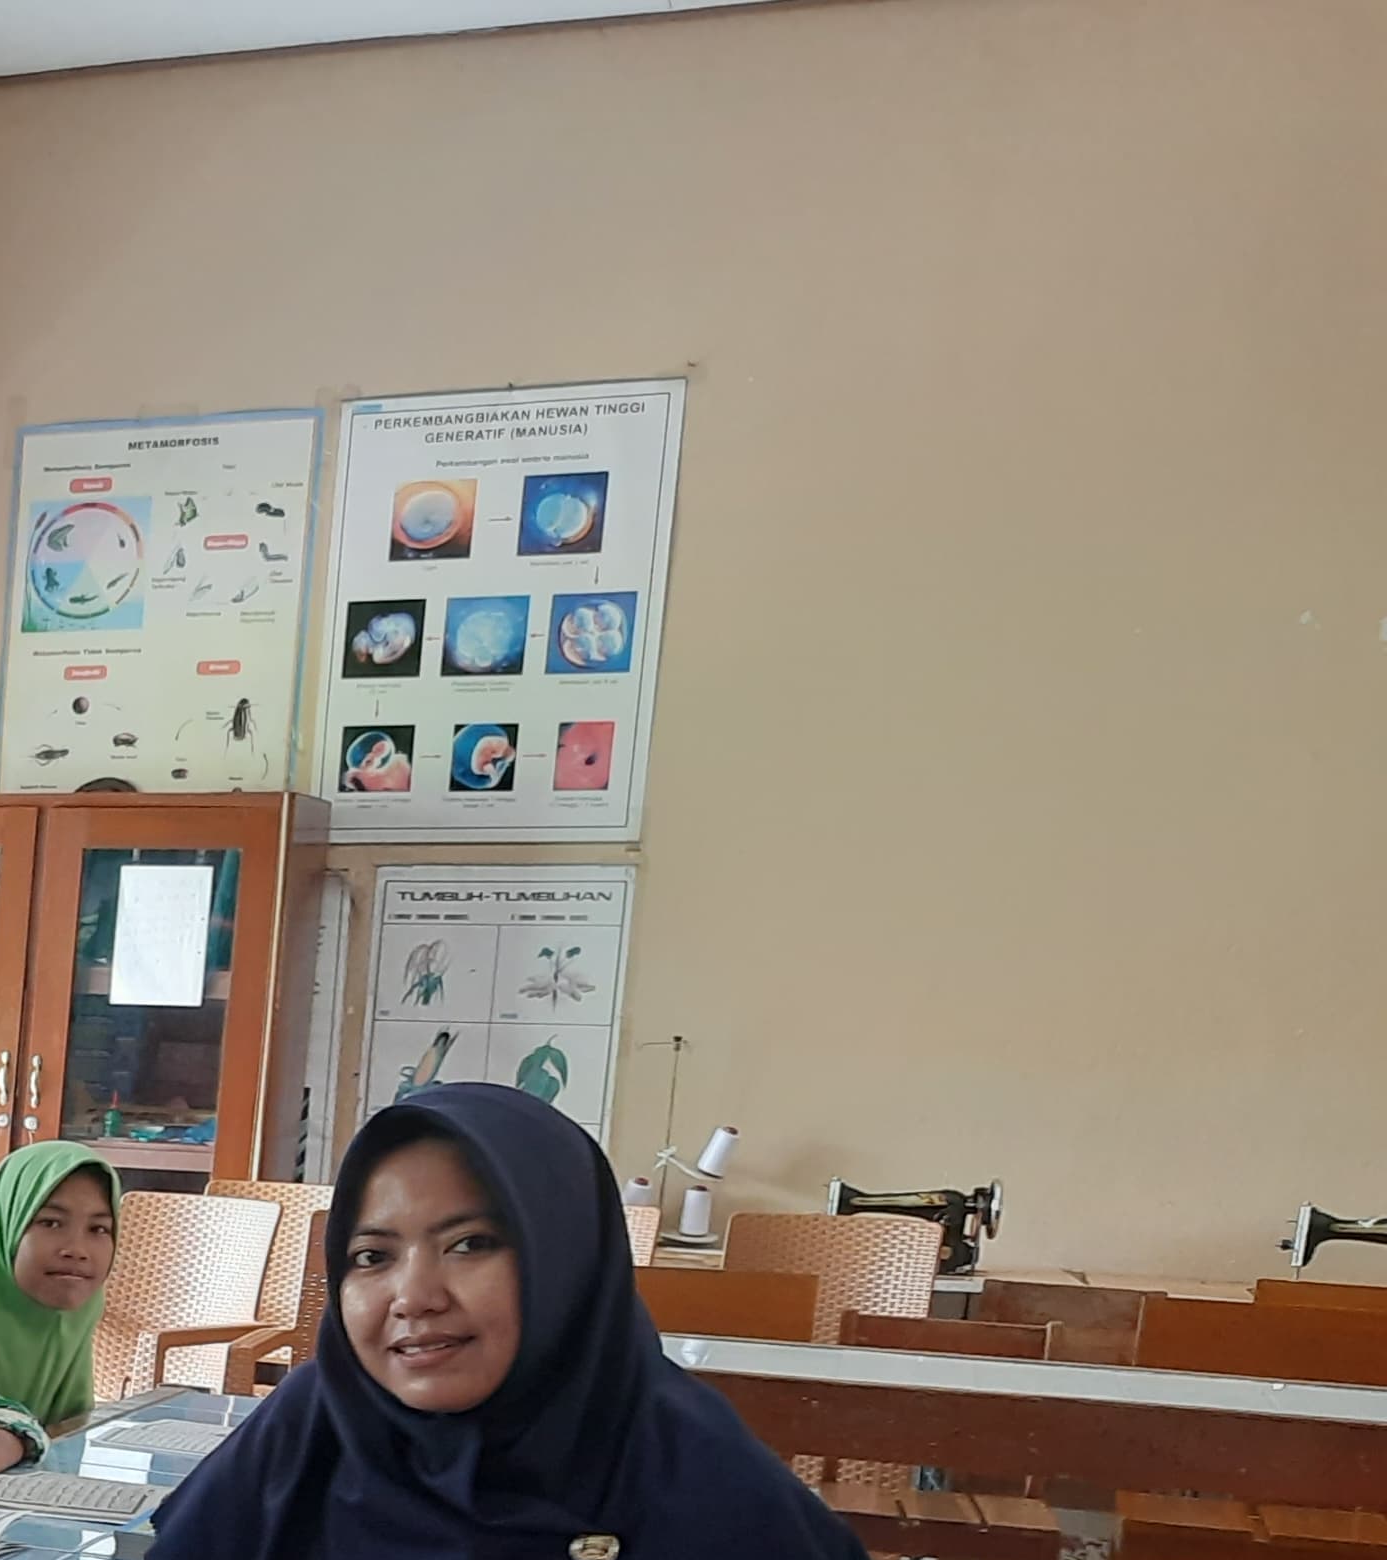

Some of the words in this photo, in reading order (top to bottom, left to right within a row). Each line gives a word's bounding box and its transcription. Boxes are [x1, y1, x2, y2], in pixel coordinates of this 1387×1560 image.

[374, 409, 531, 430] PERKEMBANGBIAKAN
[535, 405, 589, 420] HEWAN
[594, 402, 645, 416] TINGGI
[424, 429, 506, 443] GENERATIF
[510, 423, 588, 441] (MANUSIA)
[128, 436, 220, 450] METAMORFOSIS
[397, 891, 612, 902] TUMBUH-TUMBUHAN
